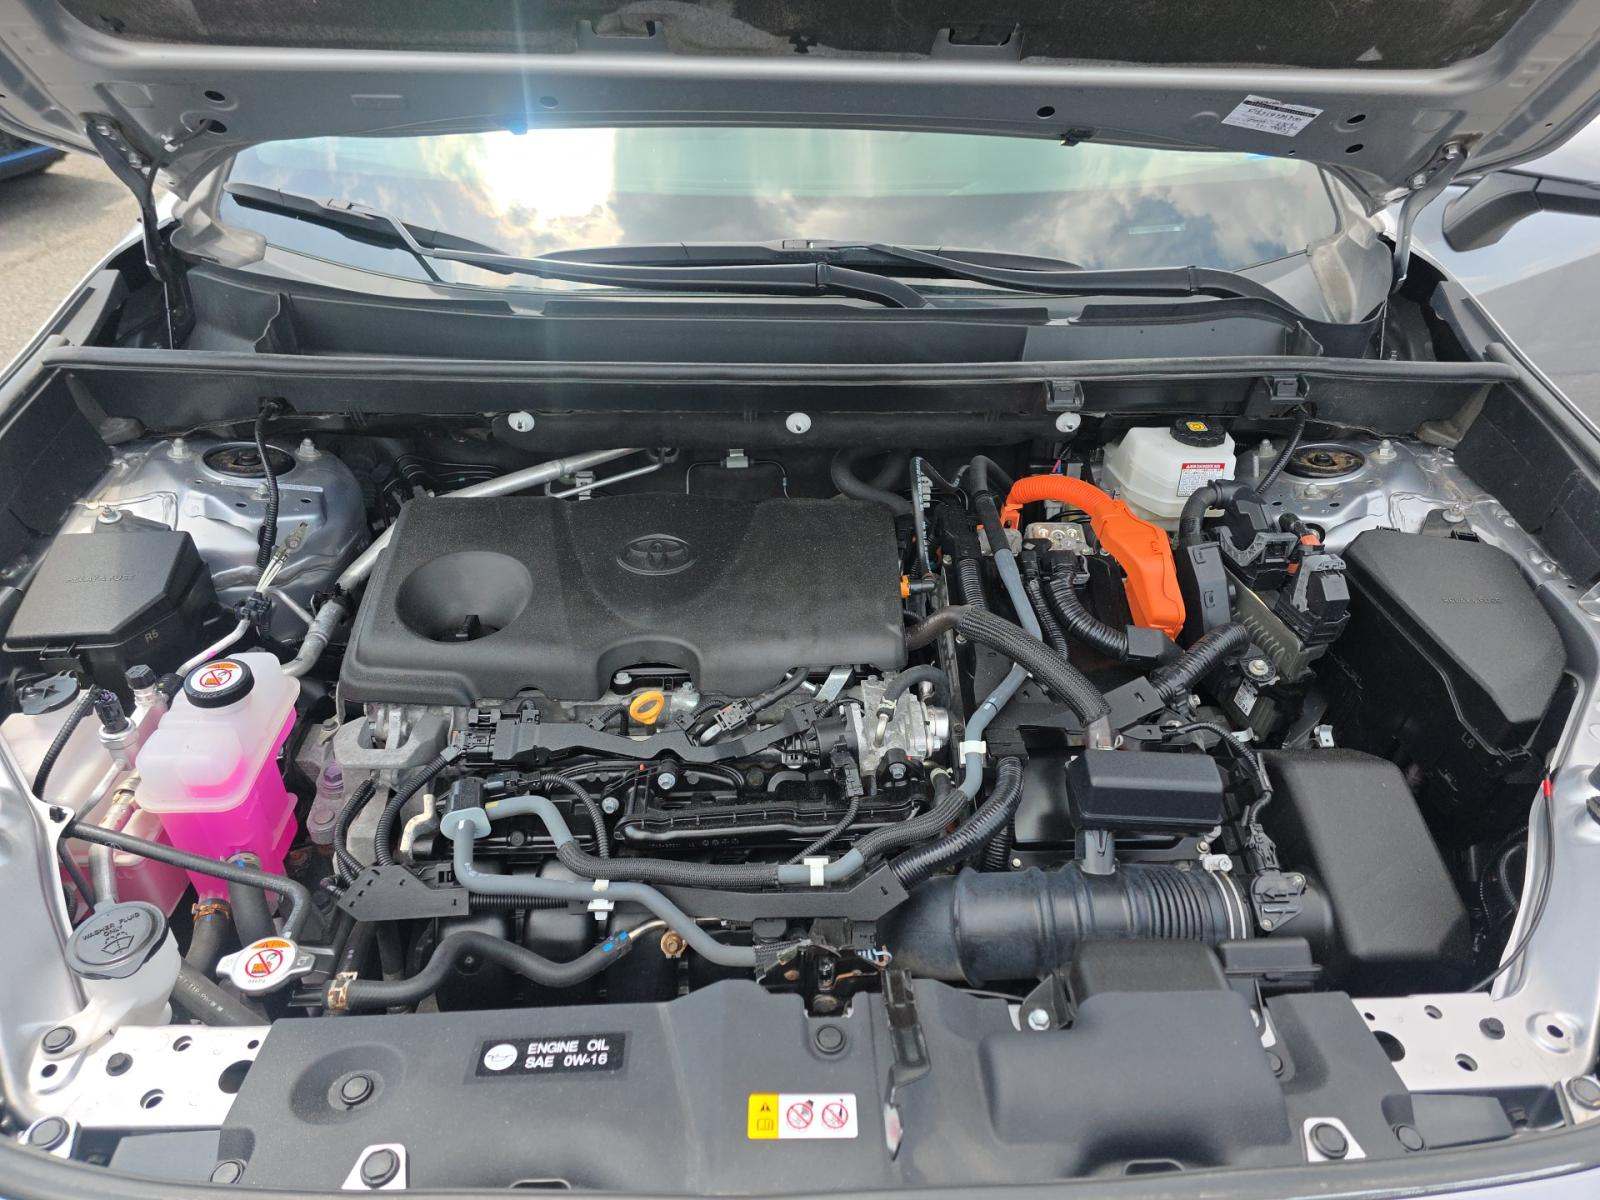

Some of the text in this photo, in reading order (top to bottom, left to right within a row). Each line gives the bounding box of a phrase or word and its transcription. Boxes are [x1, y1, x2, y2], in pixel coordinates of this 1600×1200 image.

[82, 923, 115, 940] WASHER
[104, 925, 123, 936] ONLY
[527, 1038, 609, 1055] ENGINE OIL
[524, 1052, 608, 1069] SAE 0W-16
